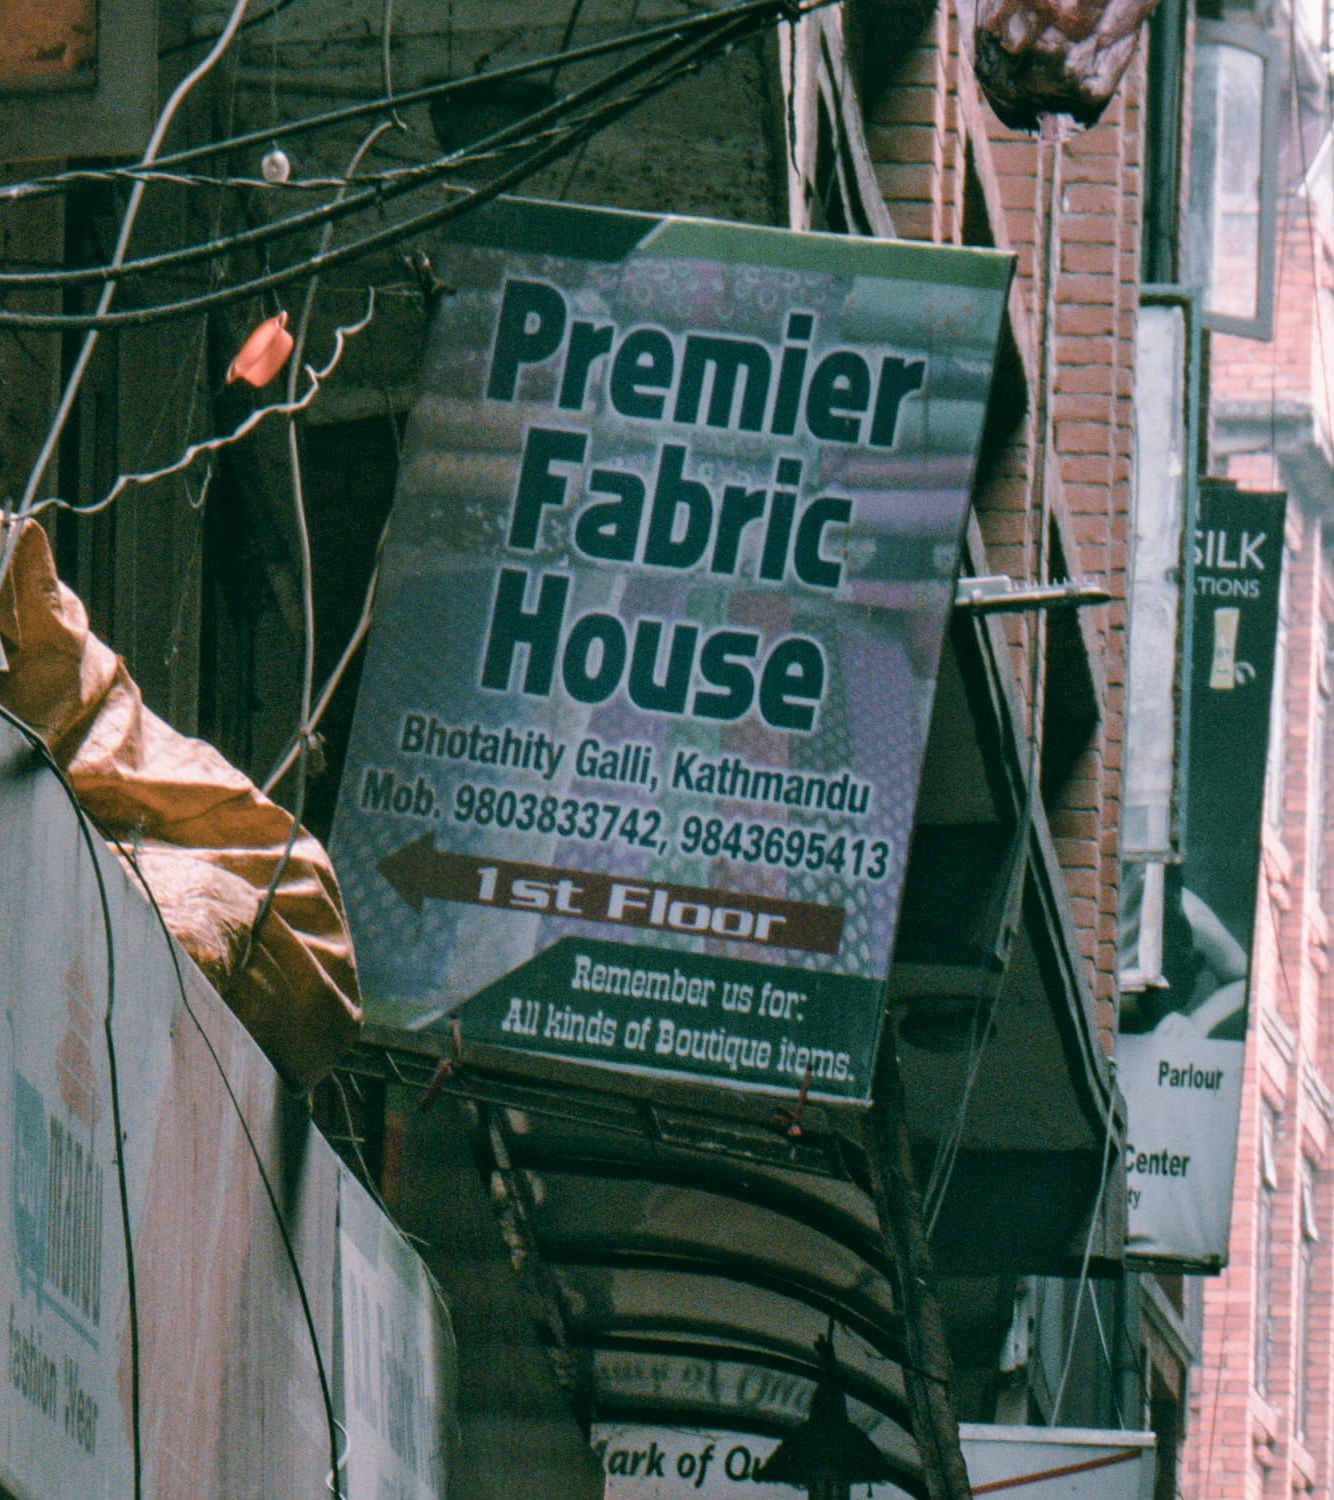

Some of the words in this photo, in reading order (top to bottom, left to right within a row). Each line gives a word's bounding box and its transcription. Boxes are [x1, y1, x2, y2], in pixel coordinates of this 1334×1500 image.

[486, 277, 927, 449] Premier
[505, 426, 853, 591] Fabric
[480, 568, 826, 733] House
[401, 714, 569, 776] Bhotahity
[574, 738, 659, 795] Galli,
[671, 752, 871, 816] Kathmandu
[361, 771, 440, 818] Mob.
[455, 783, 667, 858] 9803833742,
[680, 820, 891, 882] 9843695413
[478, 865, 583, 916] 1st
[605, 883, 787, 943] Floor
[572, 955, 713, 1010] Remember
[720, 977, 757, 1013] us
[760, 981, 808, 1023] for:
[501, 998, 539, 1037] All
[544, 1002, 617, 1050] kinds
[624, 1013, 651, 1053] of
[655, 1021, 773, 1073] Boutique
[776, 1041, 855, 1084] items.
[1158, 1060, 1224, 1090] Parlour
[595, 1440, 665, 1478] ark
[678, 1446, 714, 1488] of
